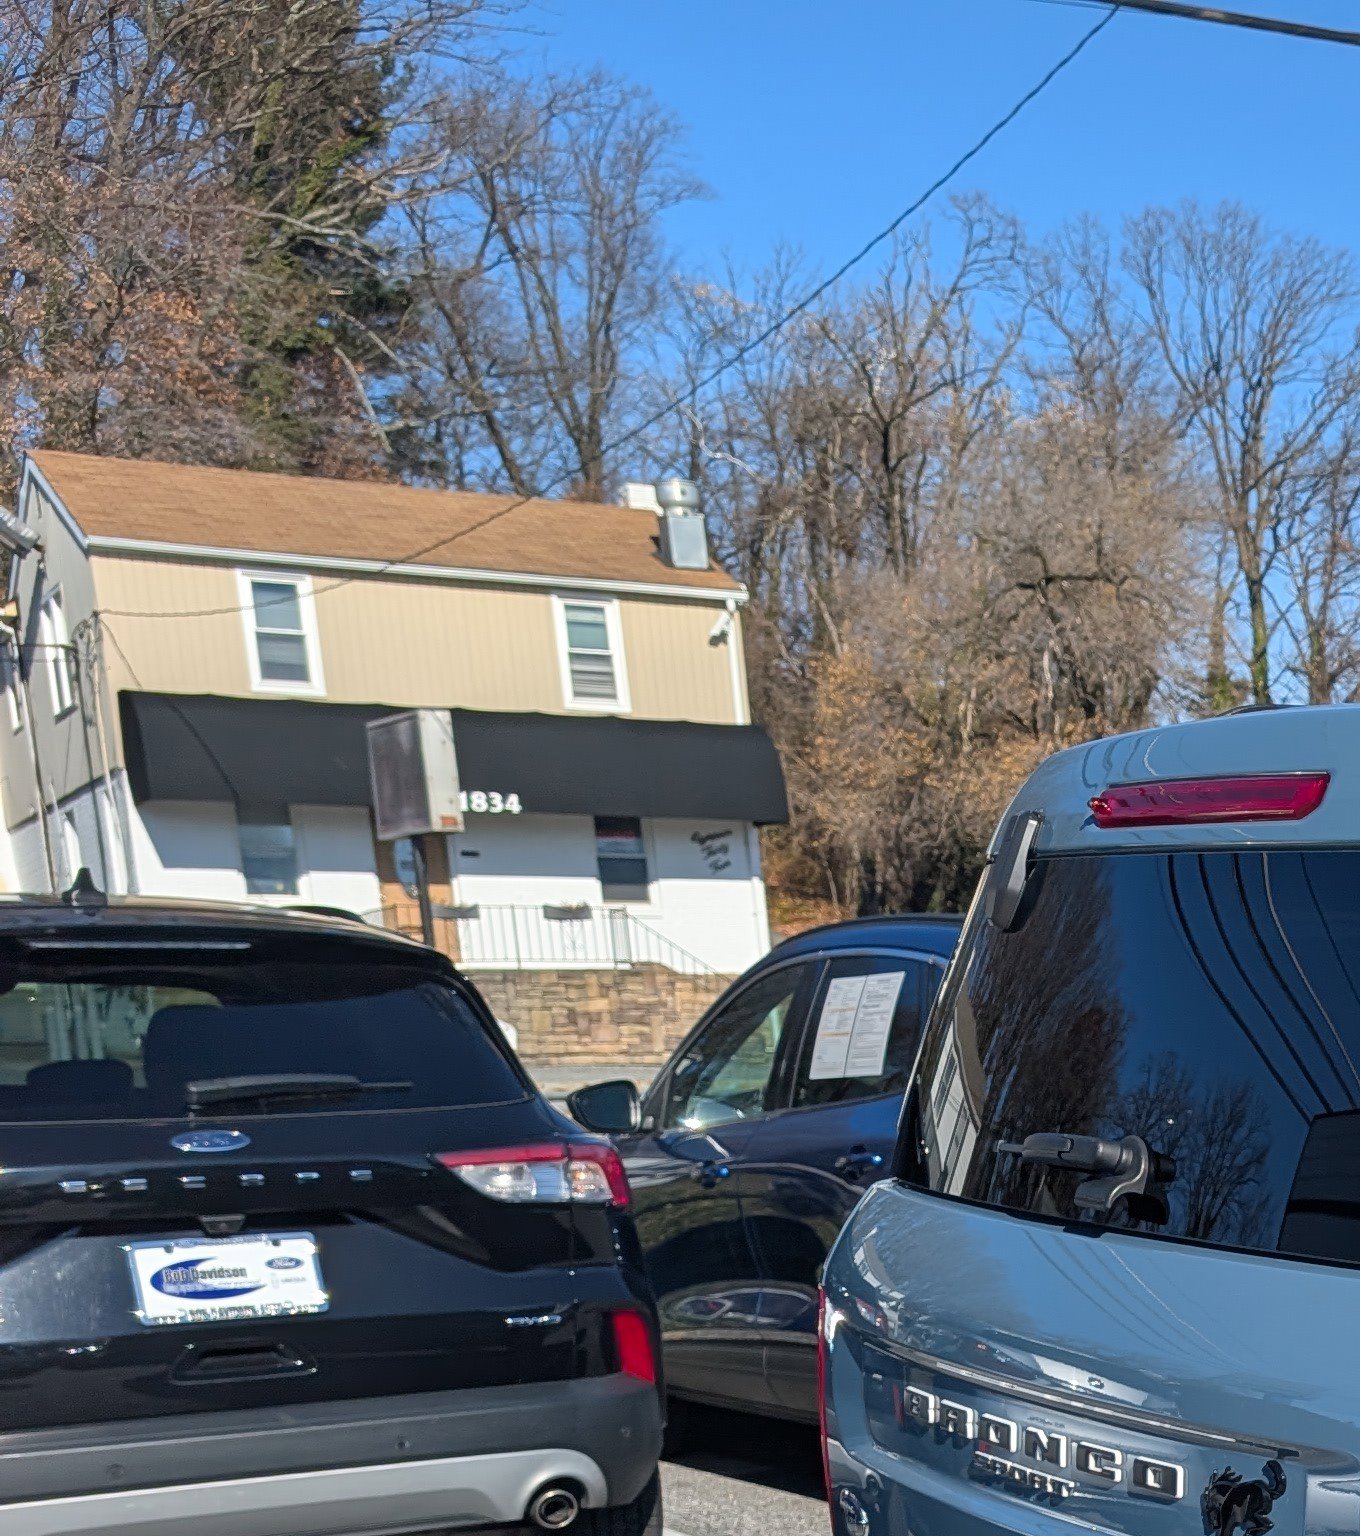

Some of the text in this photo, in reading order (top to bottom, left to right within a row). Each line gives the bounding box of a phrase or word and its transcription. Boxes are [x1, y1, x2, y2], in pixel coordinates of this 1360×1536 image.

[458, 790, 522, 814] 1834
[163, 1265, 248, 1284] Bob Davidson
[903, 1385, 1186, 1500] BRONCO
[973, 1450, 1077, 1499] SPORT
